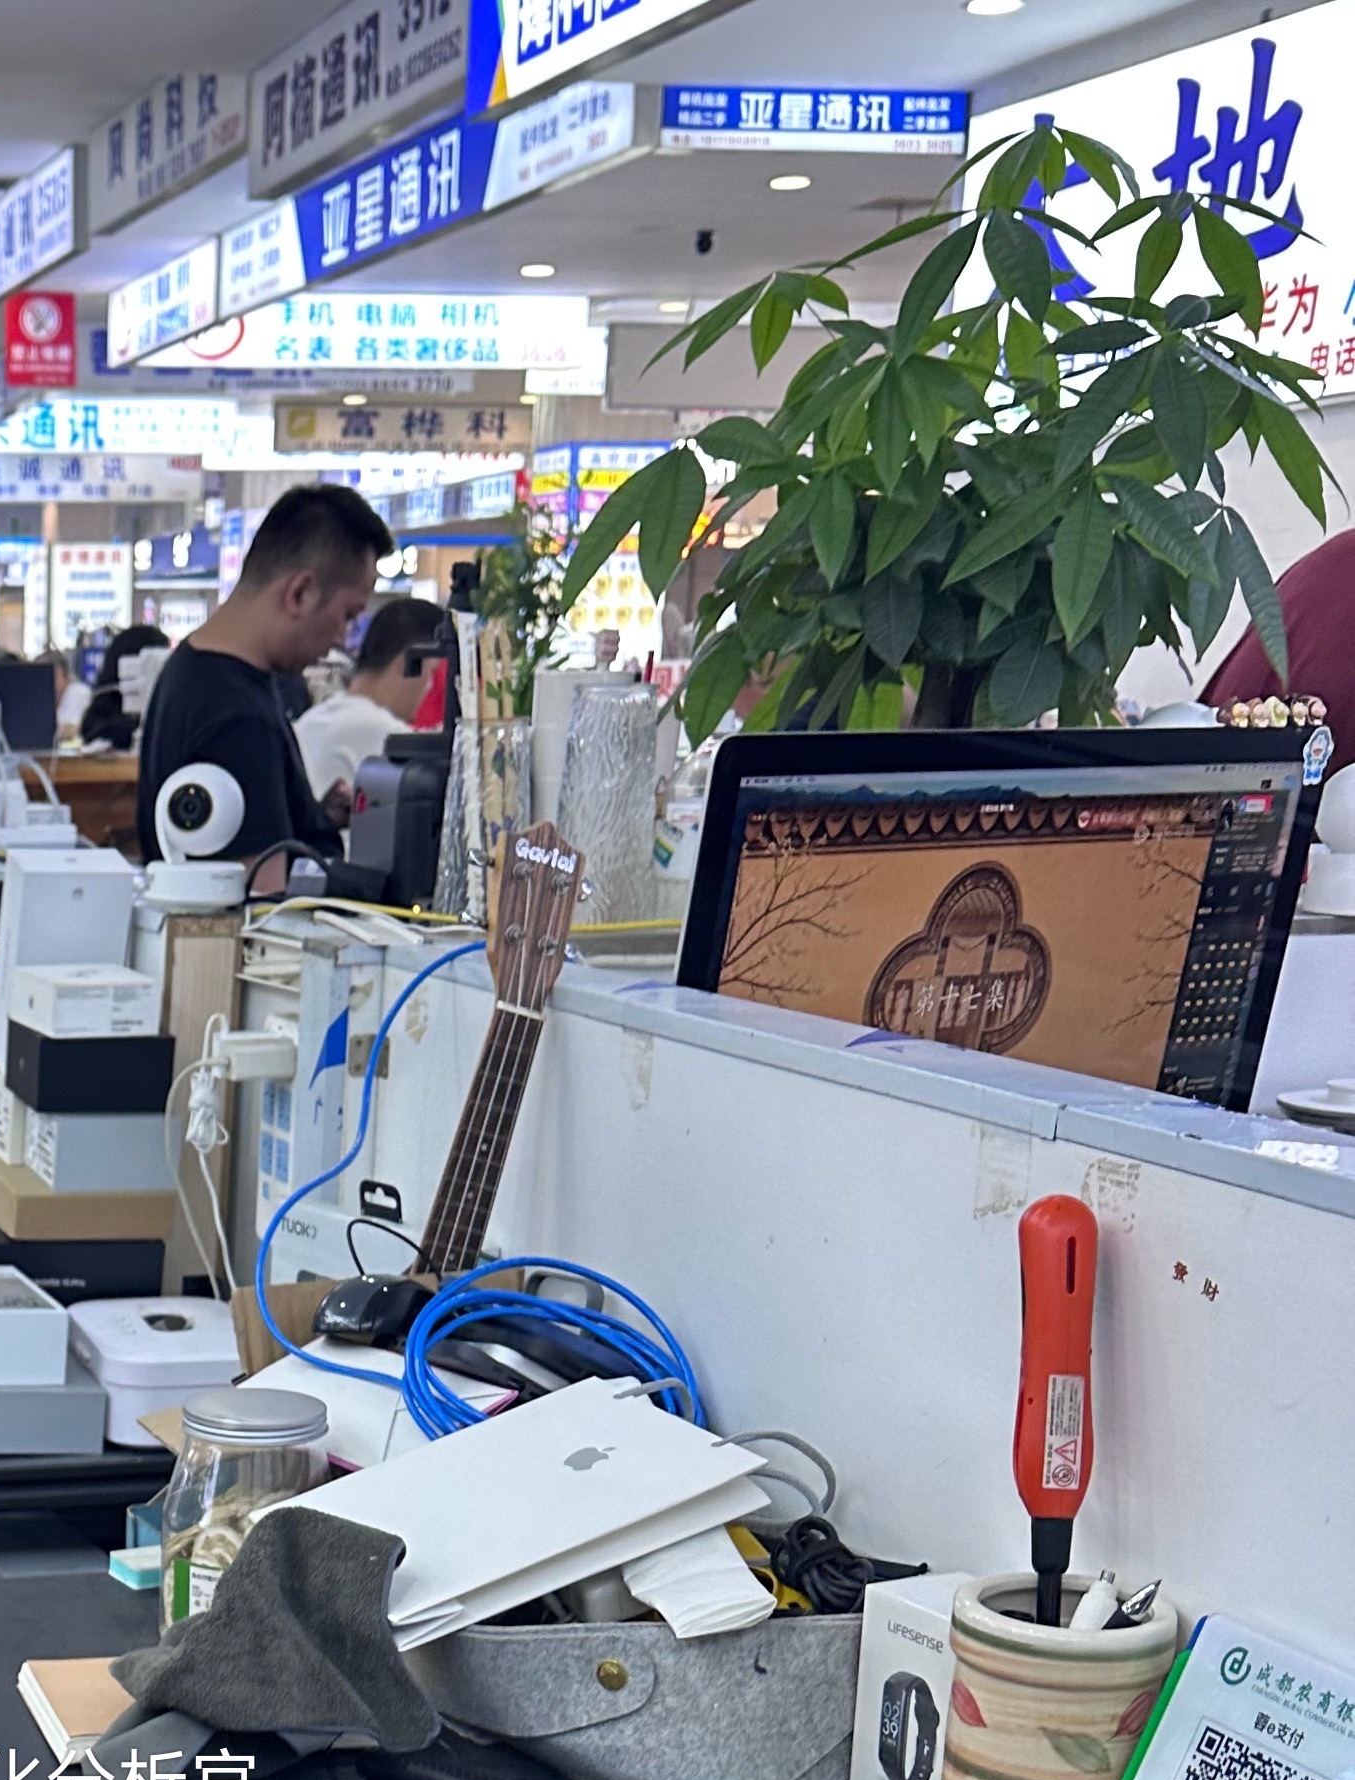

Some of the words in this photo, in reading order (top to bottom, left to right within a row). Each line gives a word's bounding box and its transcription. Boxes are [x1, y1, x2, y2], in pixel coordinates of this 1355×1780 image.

[739, 91, 891, 131] 亚星通讯
[321, 128, 461, 268] 亚星通讯
[356, 304, 416, 328] 电脑
[275, 337, 333, 362] 名表
[355, 337, 500, 363] 各类奢侈品
[1309, 336, 1355, 378] 电话
[515, 837, 576, 874] Gavial
[913, 978, 1004, 1017] 第十七集
